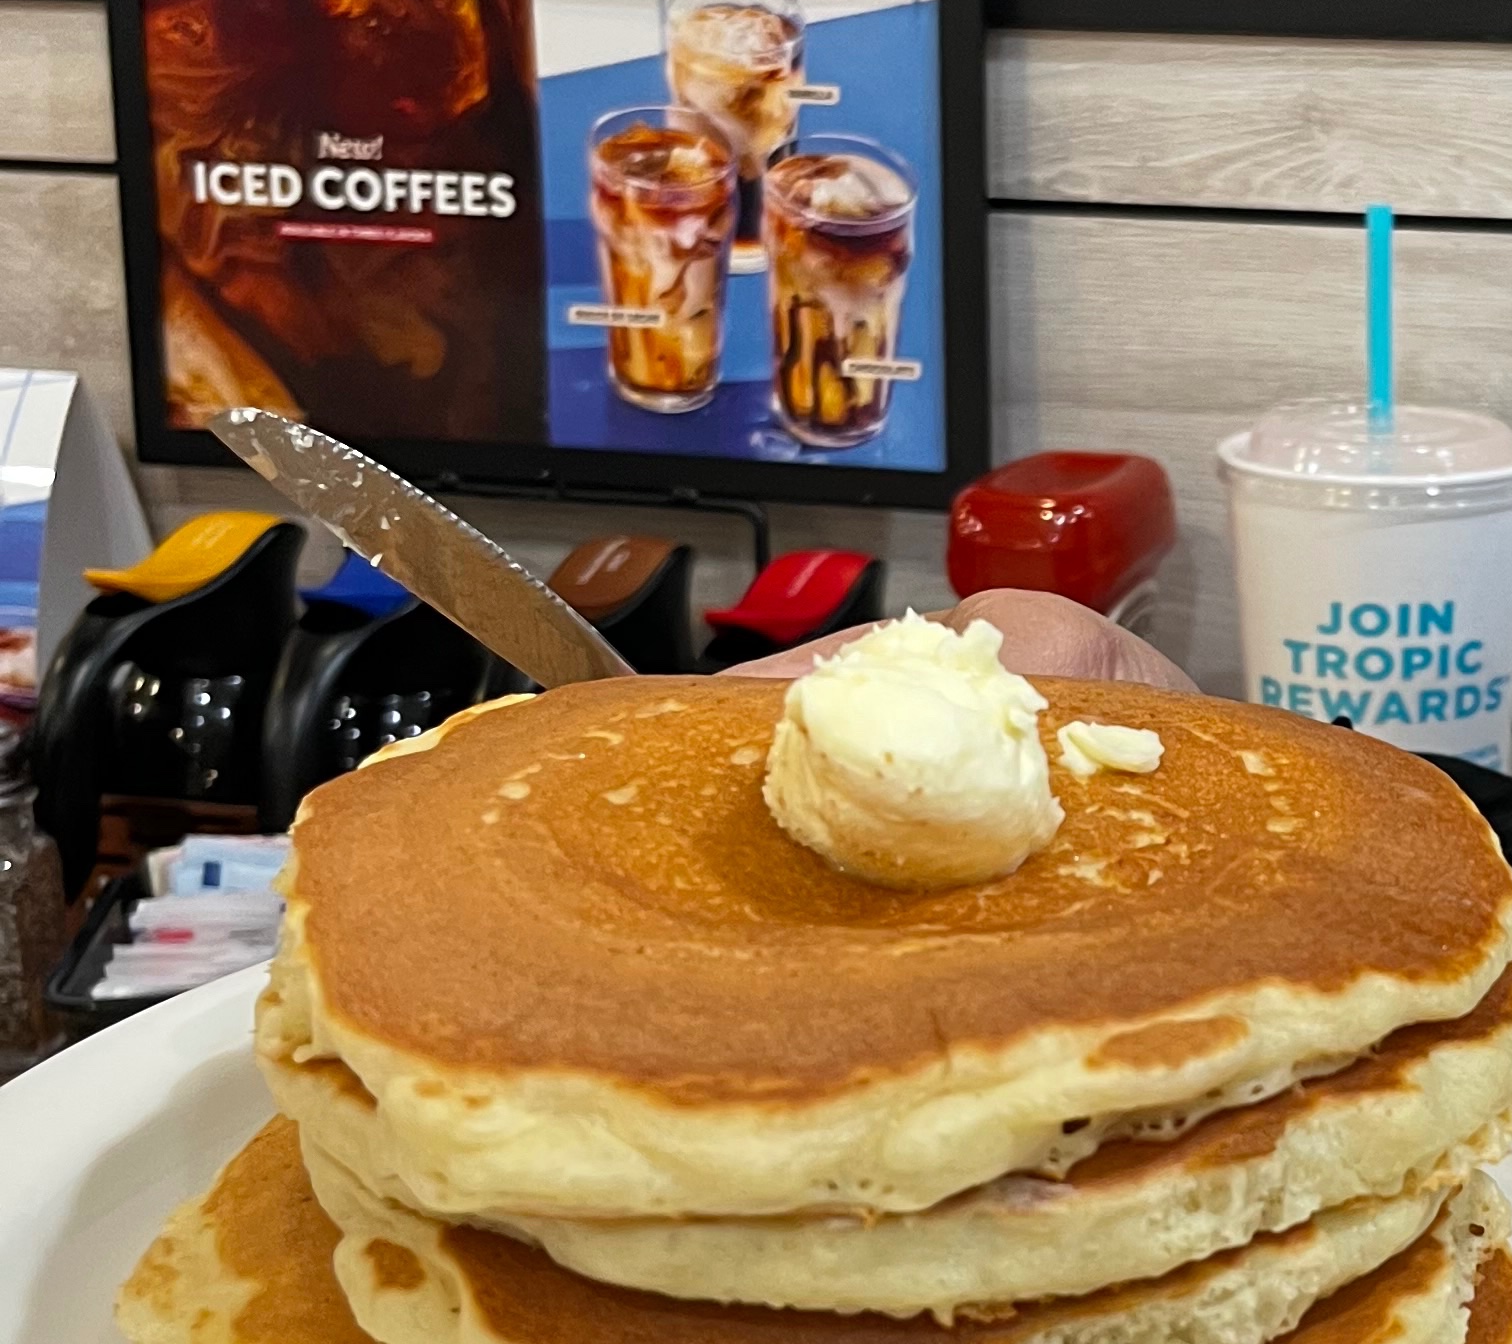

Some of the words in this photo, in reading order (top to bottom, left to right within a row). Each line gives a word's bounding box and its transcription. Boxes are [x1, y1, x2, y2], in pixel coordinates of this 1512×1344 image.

[318, 131, 384, 161] New!
[194, 160, 303, 208] ICED
[311, 164, 518, 219] COFFEES
[1317, 599, 1455, 638] JOIN
[1282, 638, 1483, 683] TROPIC
[1260, 673, 1511, 726] REWARDS
